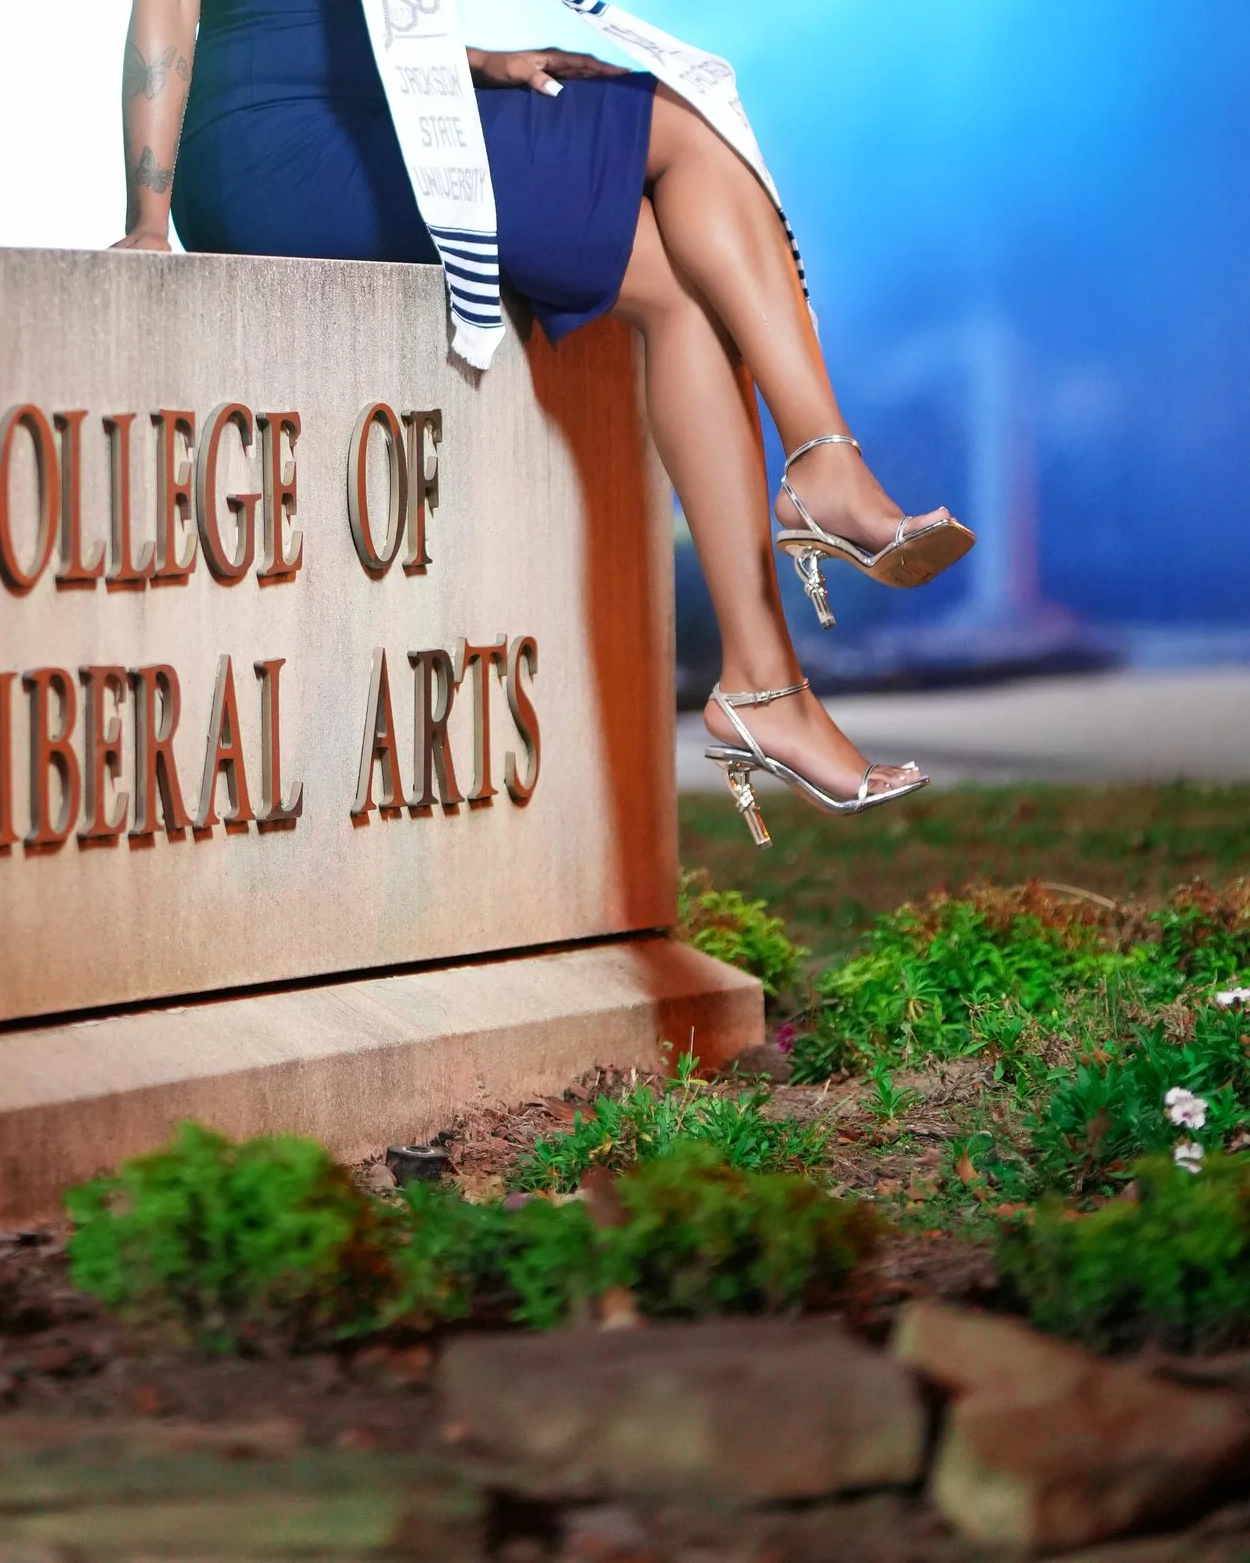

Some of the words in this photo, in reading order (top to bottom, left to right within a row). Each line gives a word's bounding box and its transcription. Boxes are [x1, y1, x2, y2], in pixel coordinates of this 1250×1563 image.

[395, 64, 464, 97] JACKSON
[418, 115, 468, 148] STATE
[412, 166, 486, 204] UNIVERSITY
[348, 402, 442, 576] OF
[351, 634, 541, 821] ARTS
